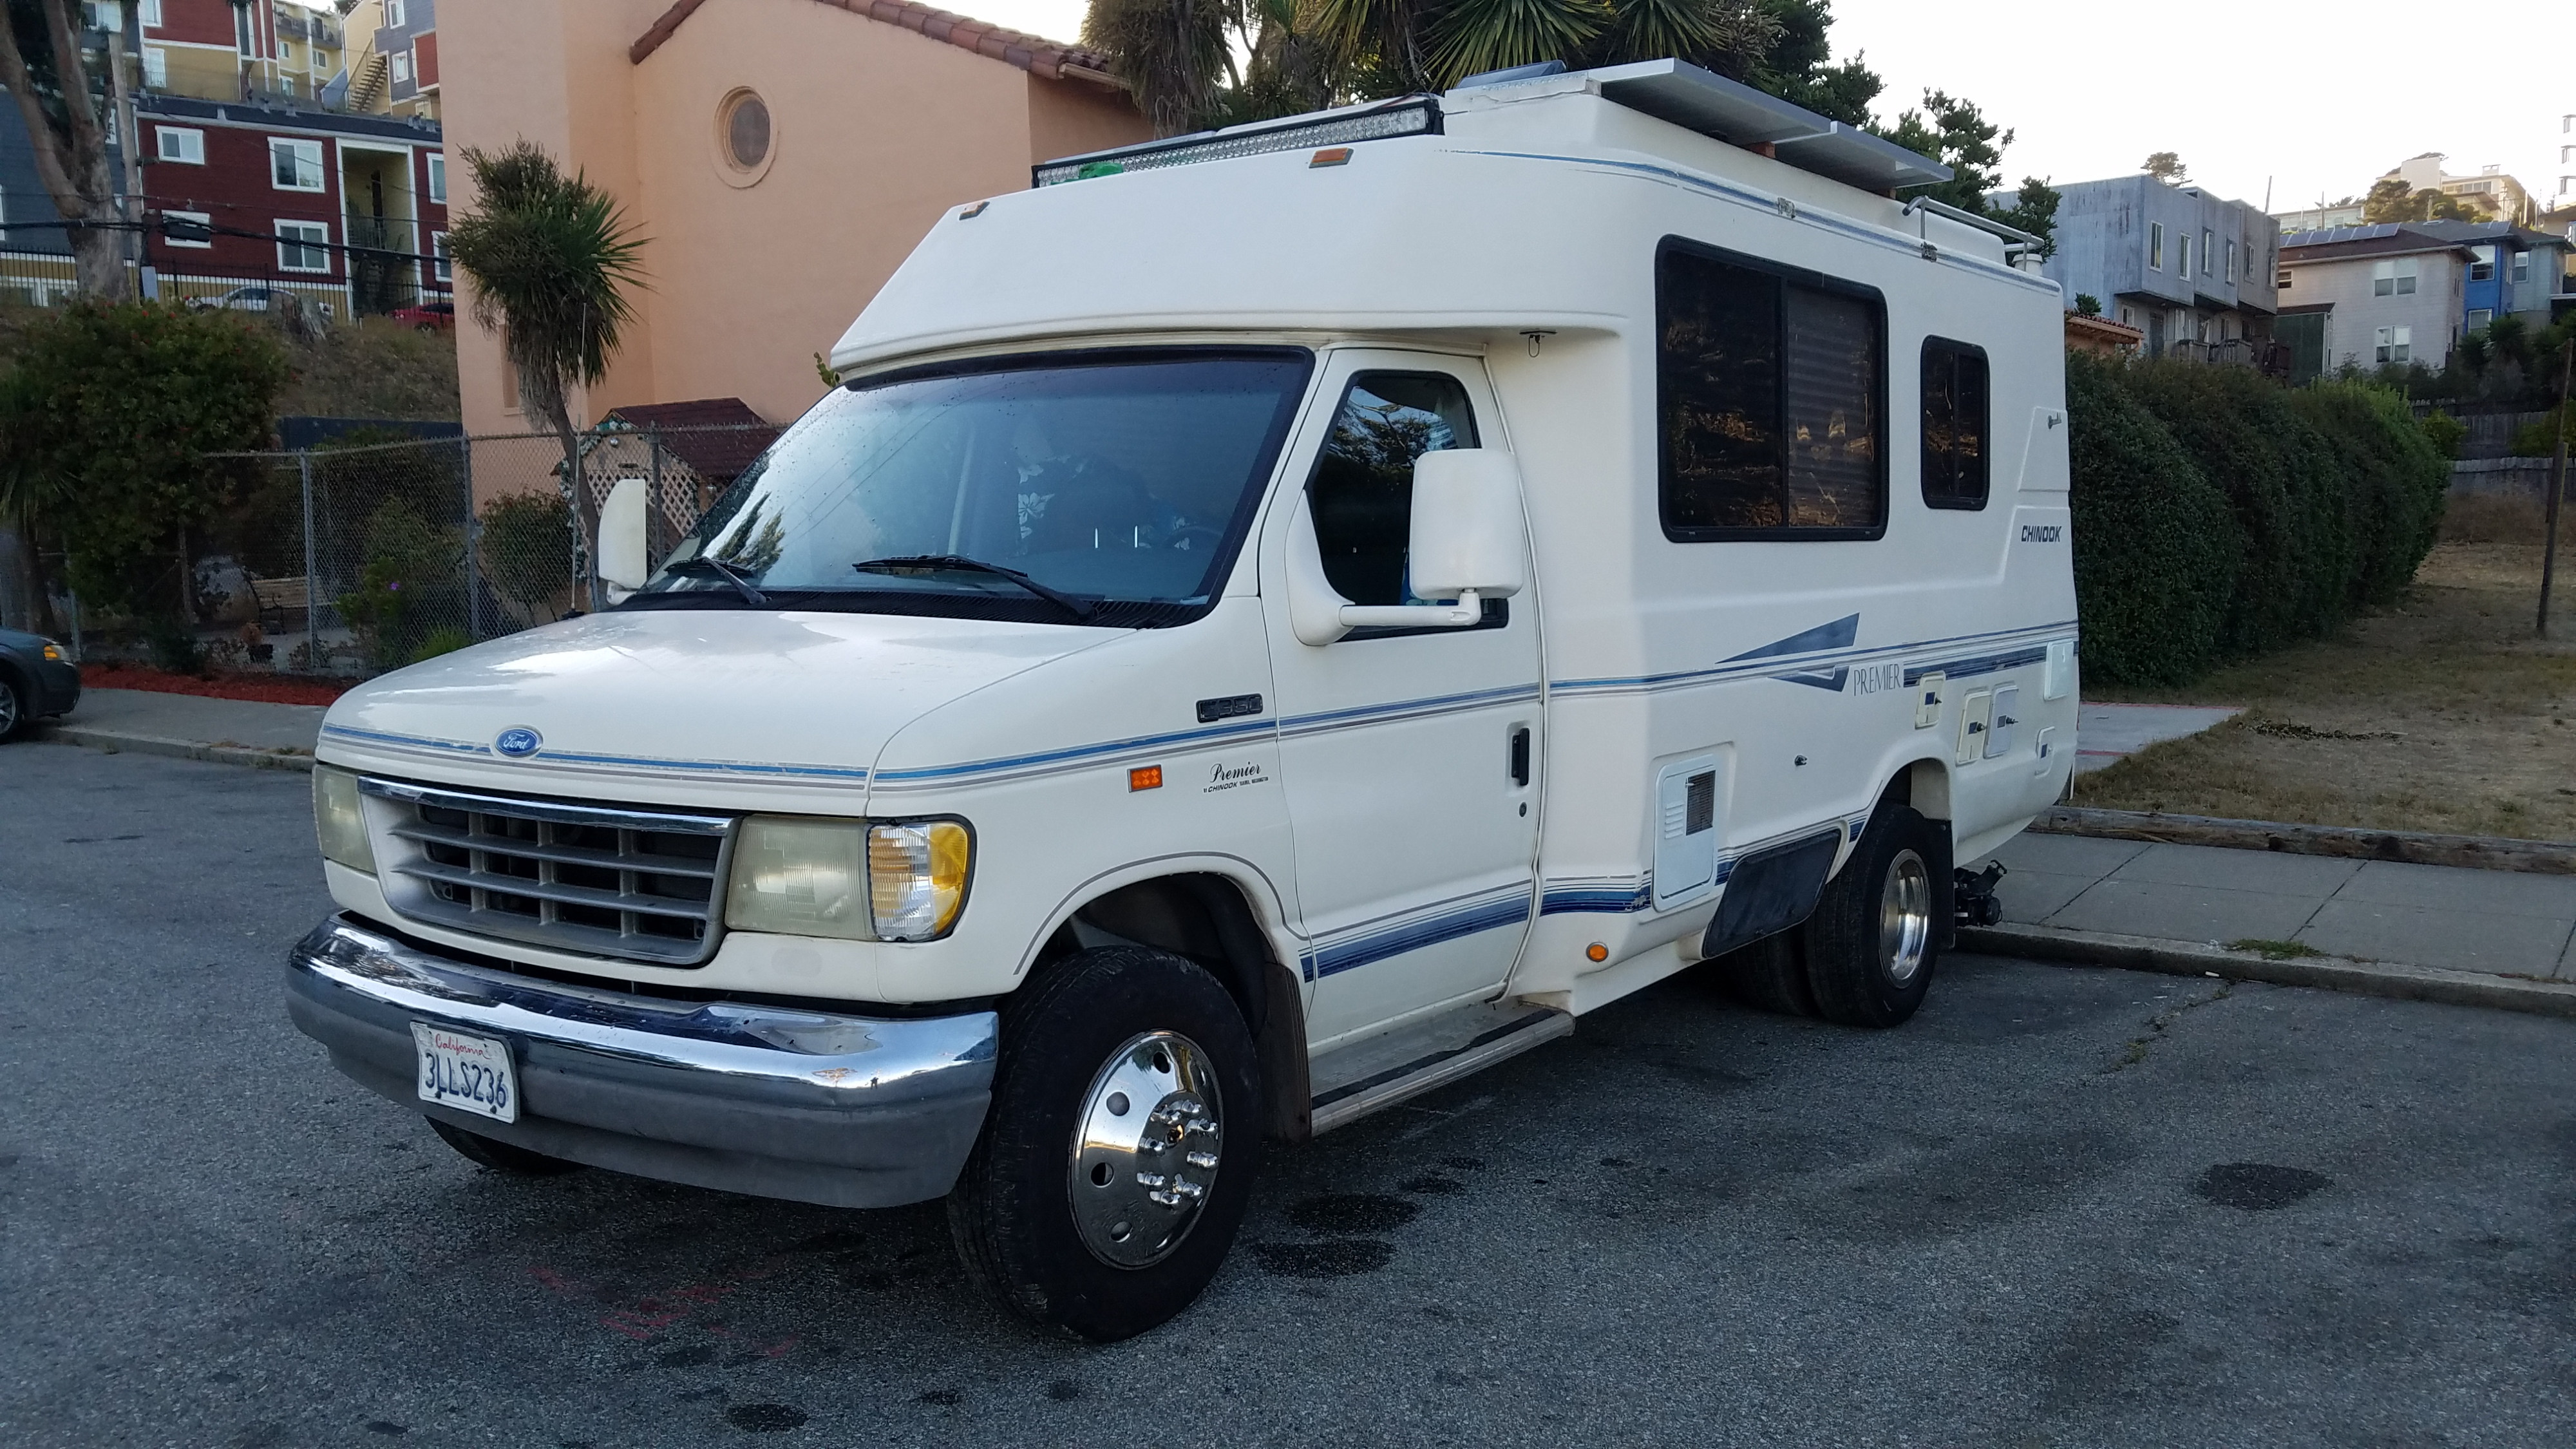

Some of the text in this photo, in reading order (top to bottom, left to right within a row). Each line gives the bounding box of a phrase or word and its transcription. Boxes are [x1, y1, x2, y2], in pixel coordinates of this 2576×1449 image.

[2022, 526, 2061, 542] CHINOOK
[1854, 664, 1900, 696] PREMIER
[504, 733, 529, 750] Ford
[1210, 761, 1261, 782] Premier
[1208, 782, 1238, 792] CHINOOK
[435, 1034, 492, 1059] California
[425, 1052, 506, 1108] 3LLS236
